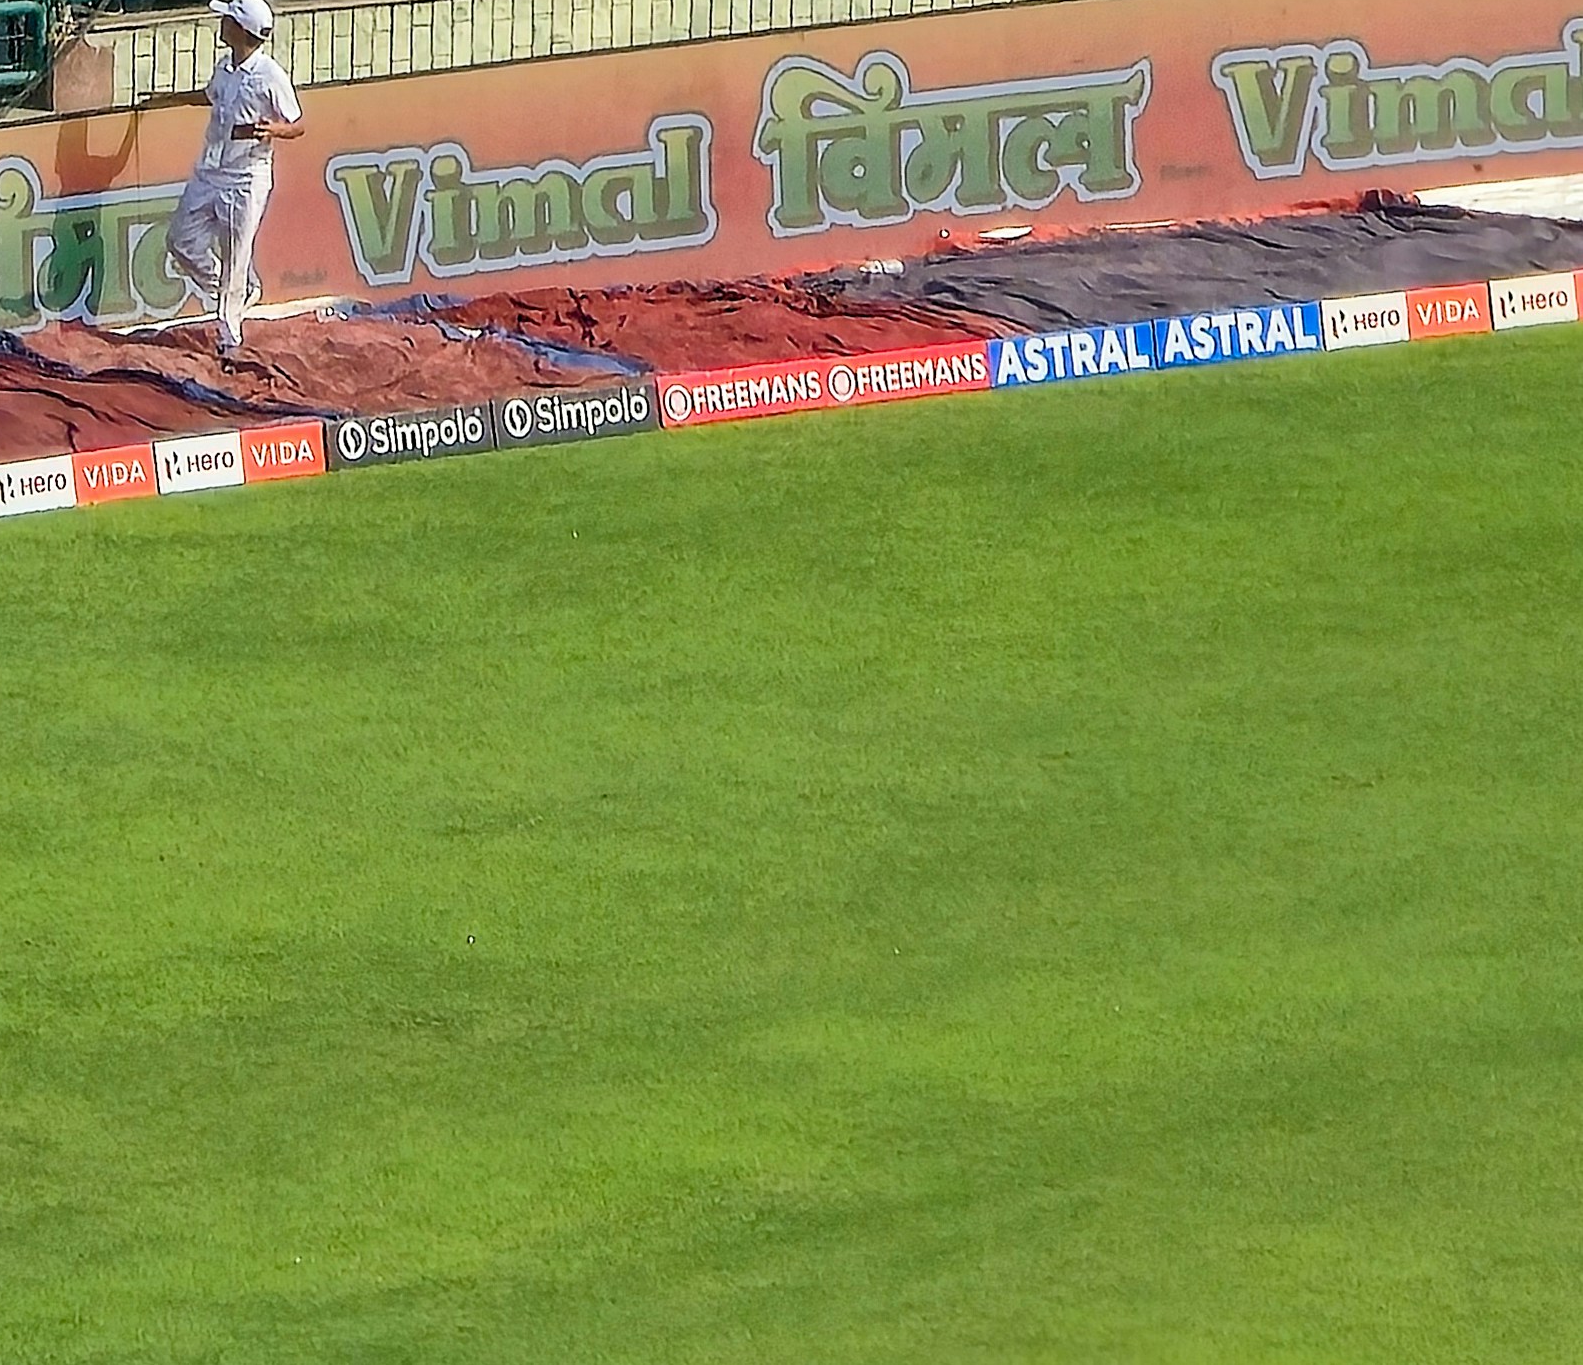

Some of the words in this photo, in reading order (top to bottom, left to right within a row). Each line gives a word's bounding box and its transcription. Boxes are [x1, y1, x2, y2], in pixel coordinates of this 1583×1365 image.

[763, 63, 1145, 227] विमल
[334, 126, 706, 277] Vimal
[1416, 298, 1480, 325] VIDA
[1522, 290, 1568, 312] Hero
[1353, 309, 1400, 331] Hero
[1165, 308, 1316, 364] ASTRAL
[998, 328, 1150, 384] ASTRAL
[856, 353, 987, 395] FREEMANS
[694, 372, 820, 413] FREEMANS
[187, 448, 234, 473] Hero
[251, 439, 315, 467] VIDA
[20, 471, 67, 497] Hero
[84, 460, 147, 488] VIDA
